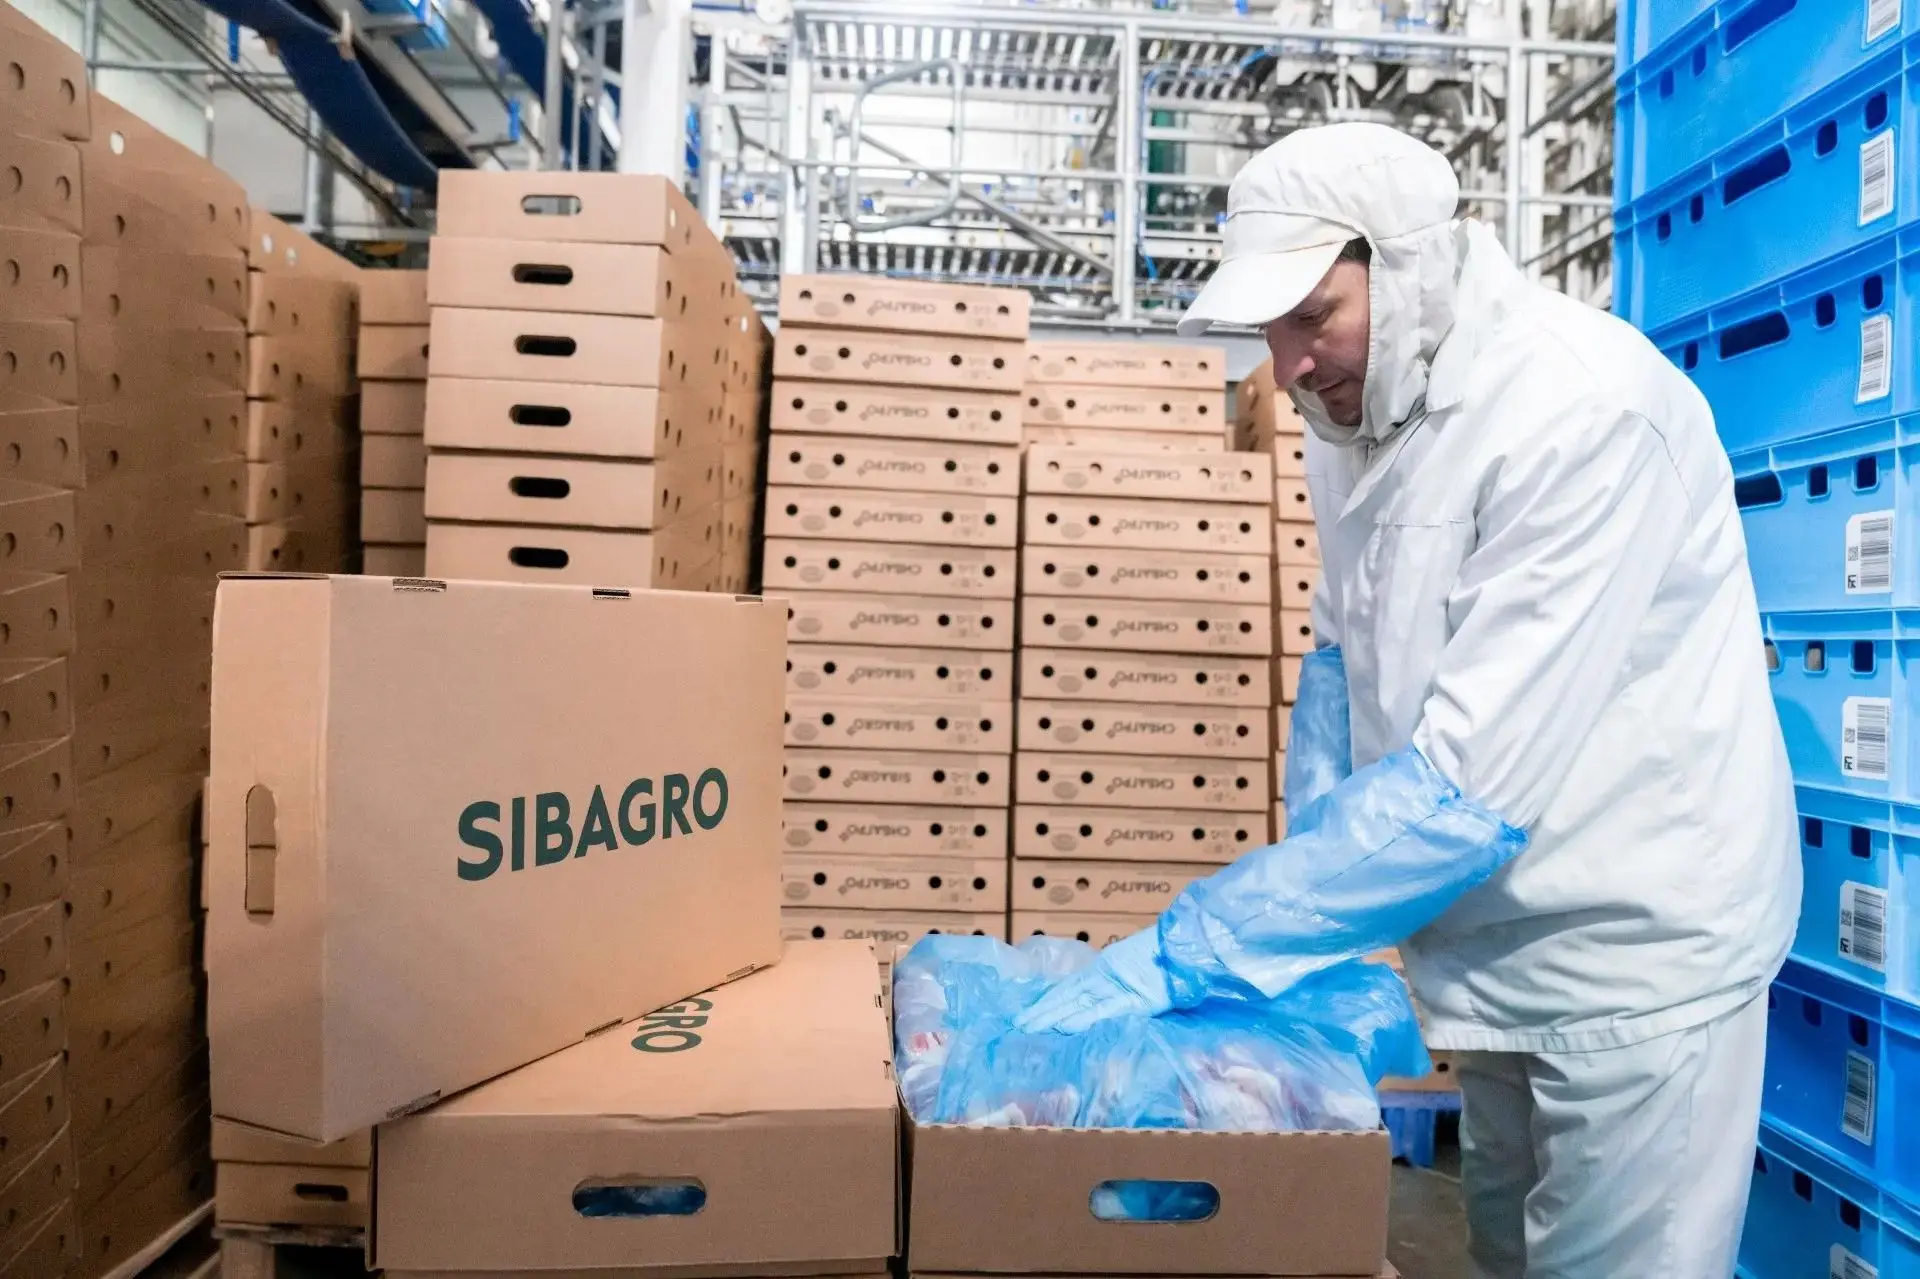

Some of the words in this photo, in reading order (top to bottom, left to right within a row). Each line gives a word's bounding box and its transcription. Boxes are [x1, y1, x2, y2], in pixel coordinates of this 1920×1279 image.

[1111, 777, 1174, 789] СИБАГРО
[457, 767, 729, 881] SIBAGRO
[1111, 829, 1174, 841] СИБАГРО
[845, 877, 909, 889] СИБАГРО
[1107, 882, 1171, 893] СИБАГРО
[631, 990, 718, 1053] GRO
